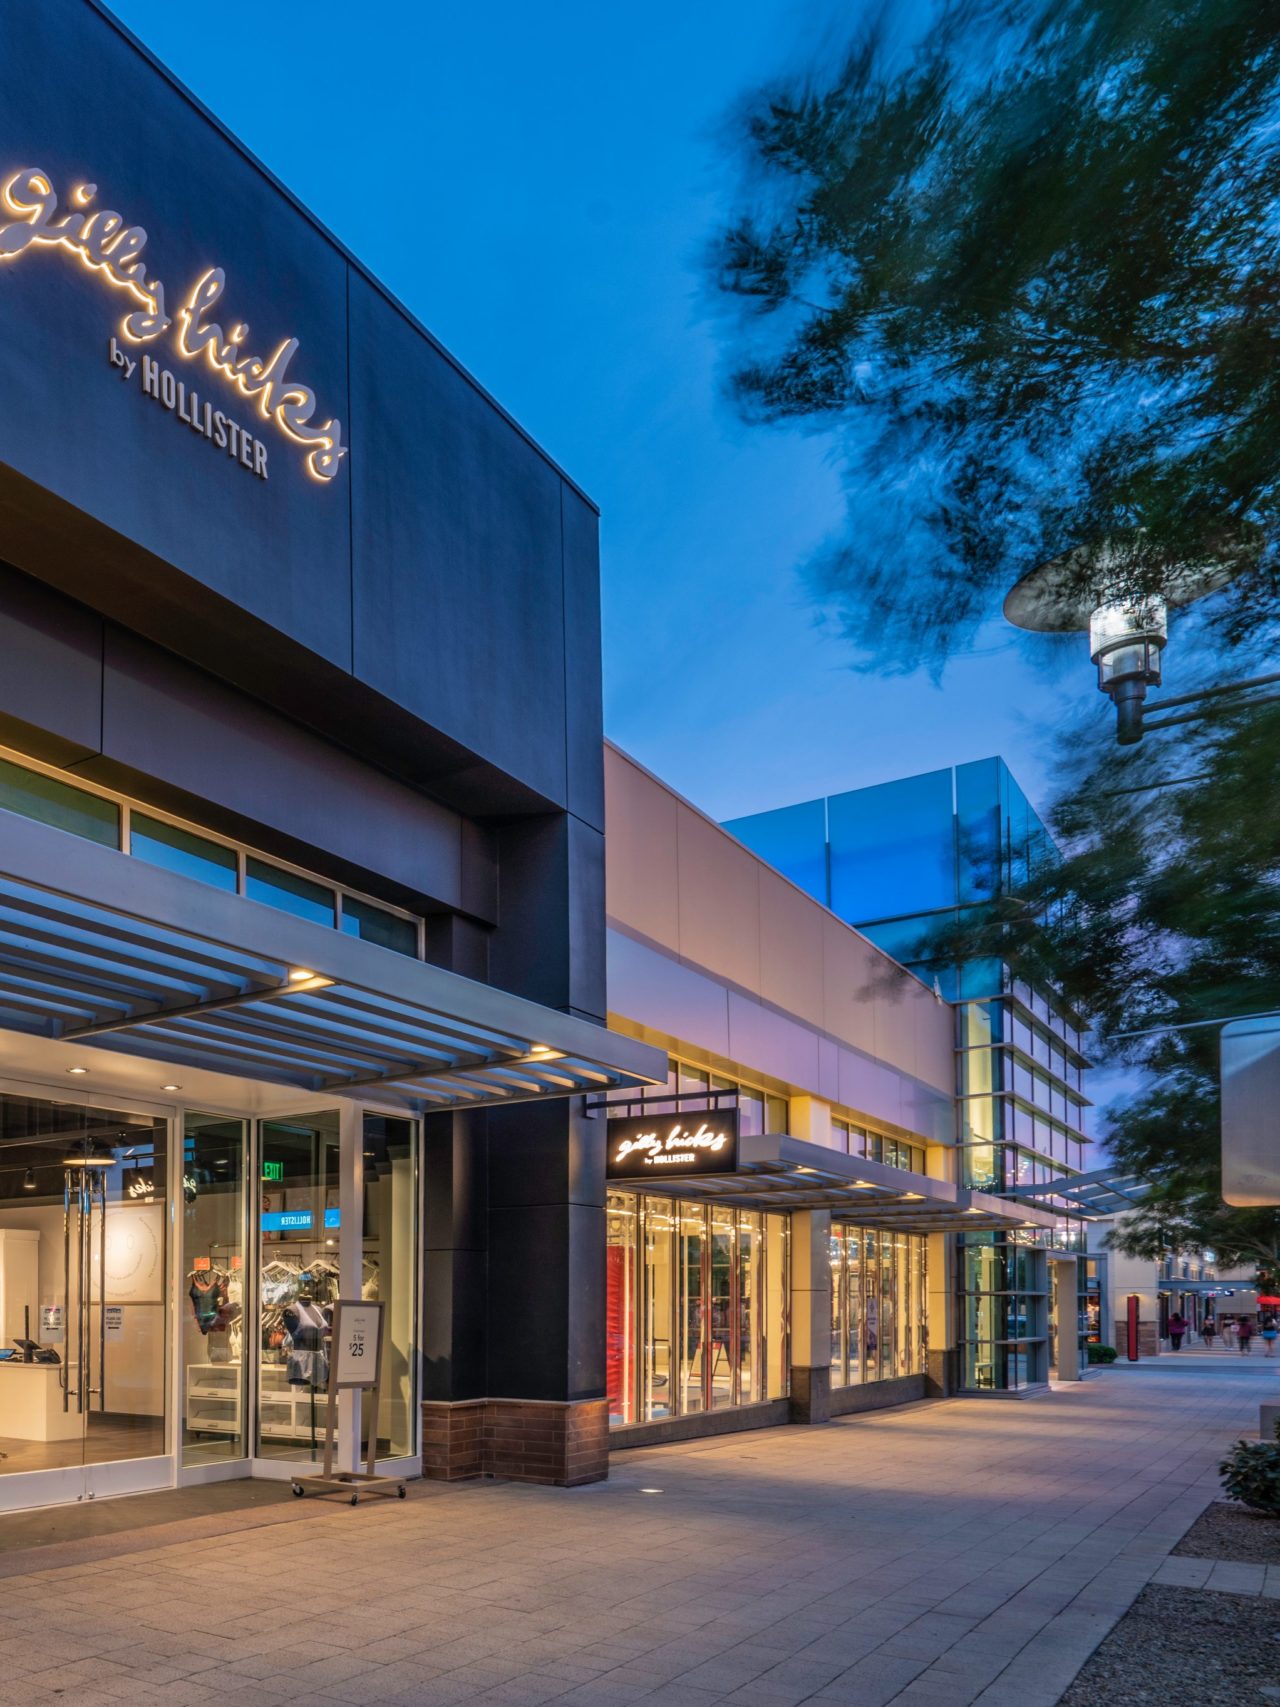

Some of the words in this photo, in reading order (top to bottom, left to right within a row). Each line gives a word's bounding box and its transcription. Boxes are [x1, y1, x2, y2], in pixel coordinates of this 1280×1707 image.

[179, 267, 349, 481] hicks
[109, 336, 137, 379] by
[141, 354, 269, 480] HOLLISTER
[615, 1132, 663, 1163] gilly
[665, 1123, 728, 1151] hicks
[264, 1162, 280, 1179] EXIT
[653, 1153, 695, 1164] HOLLISTER
[349, 1342, 364, 1357] $25
